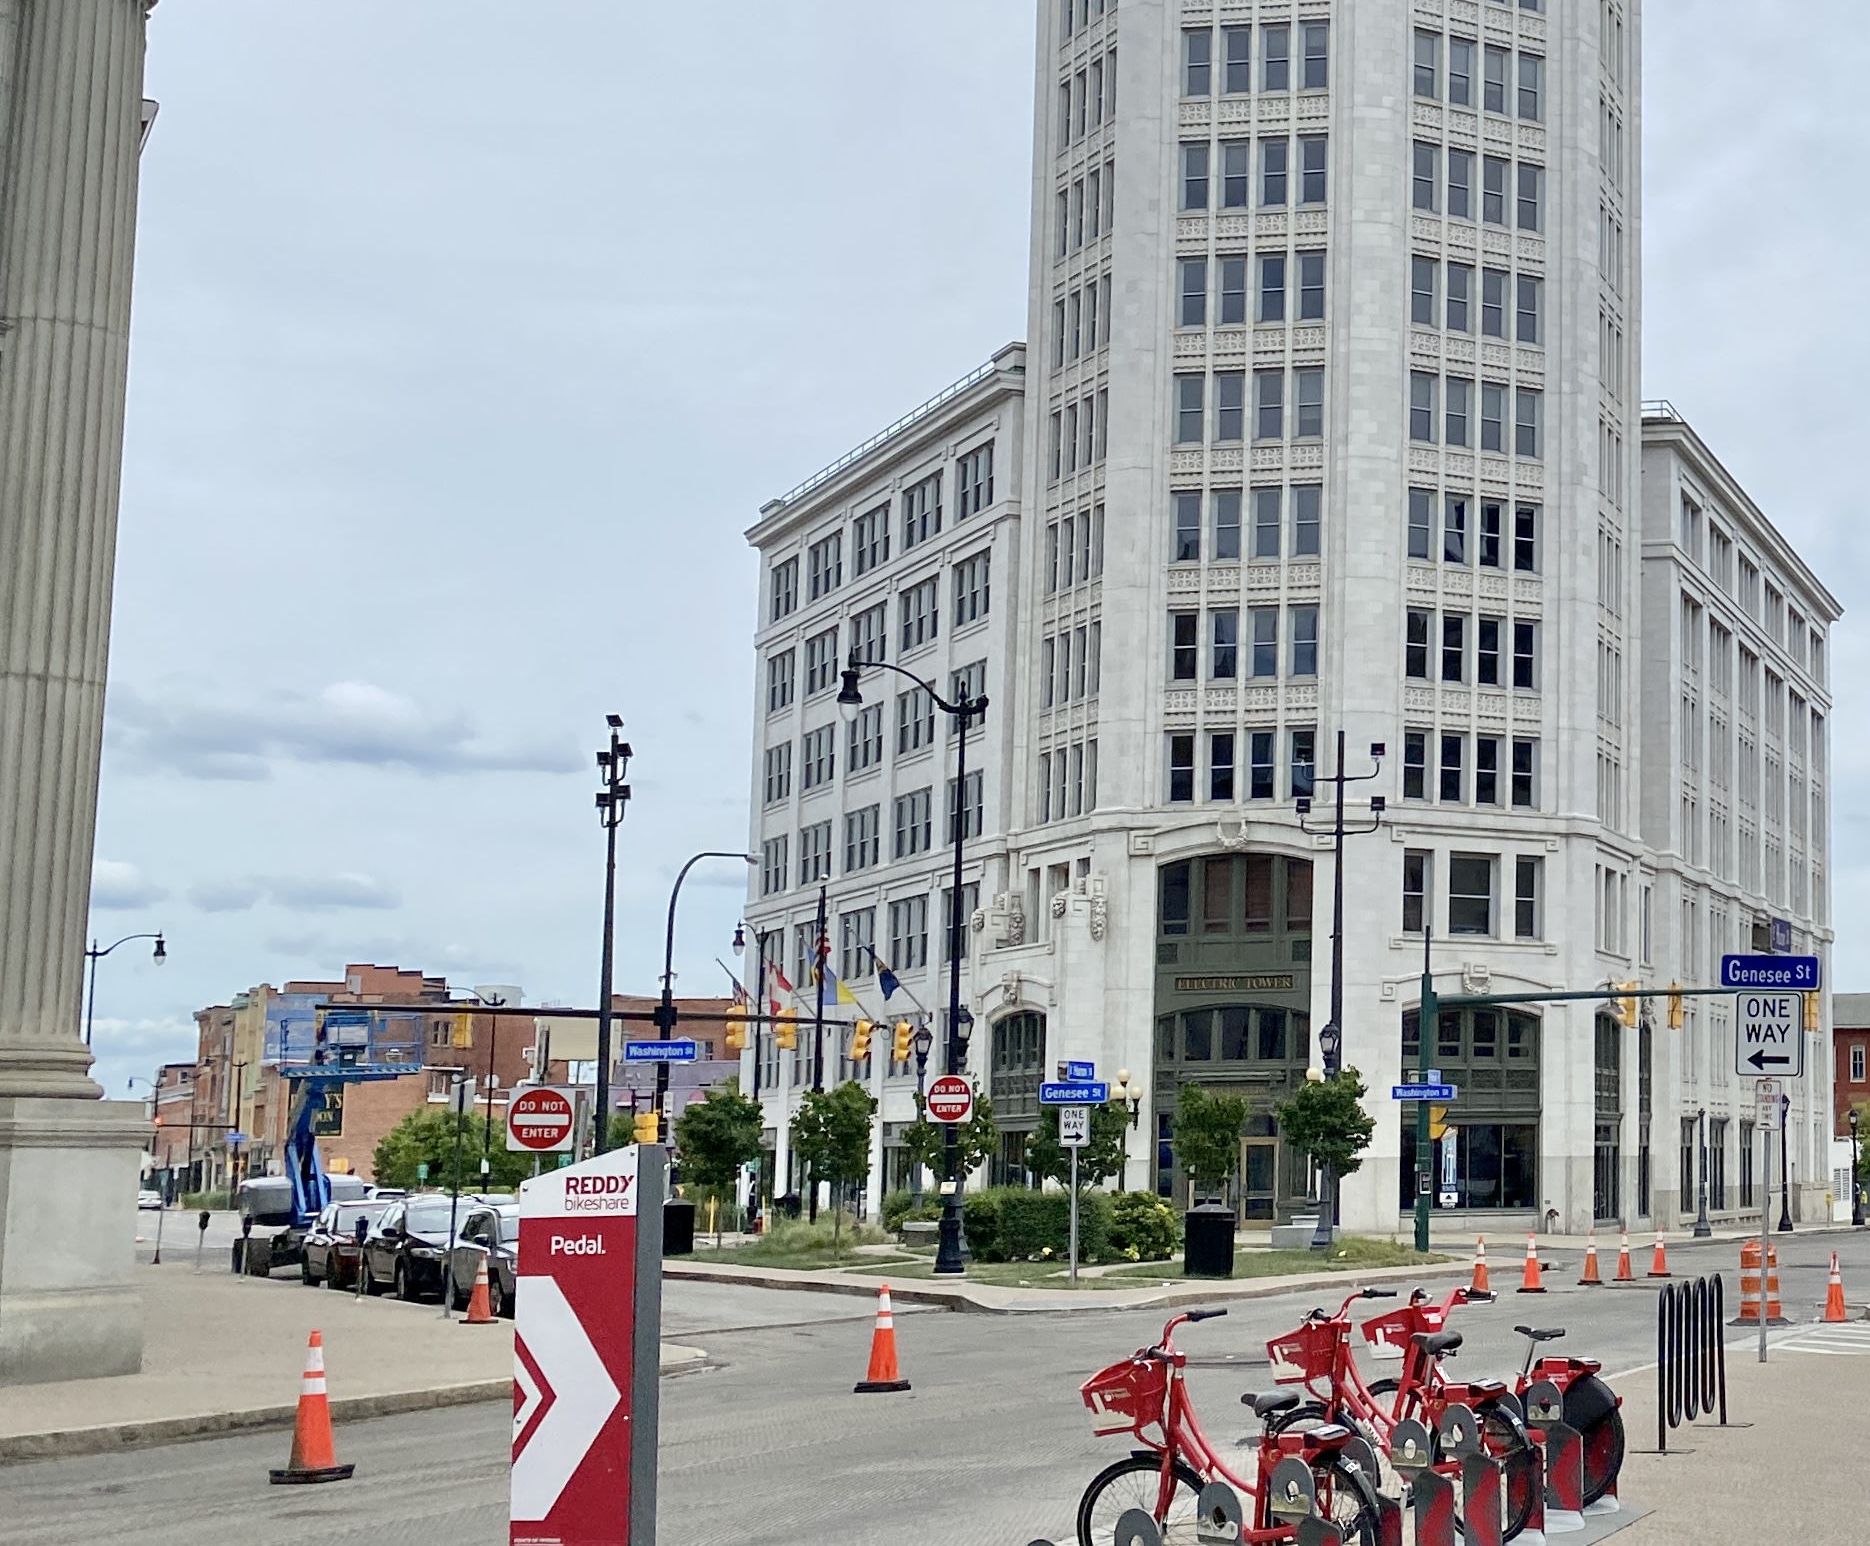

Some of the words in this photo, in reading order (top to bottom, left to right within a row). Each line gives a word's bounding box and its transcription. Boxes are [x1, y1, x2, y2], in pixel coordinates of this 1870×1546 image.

[1728, 959, 1792, 984] Genesee
[1796, 964, 1811, 980] St
[1177, 978, 1239, 990] ELECTRIC
[1245, 976, 1292, 989] TOWER
[1747, 998, 1790, 1018] ONE
[1746, 1024, 1790, 1043] WAY
[629, 1045, 684, 1059] Washington
[685, 1047, 693, 1055] St
[934, 1085, 946, 1093] DO
[948, 1085, 966, 1093] NOT
[1045, 1087, 1089, 1099] Genesee
[1092, 1088, 1102, 1097] St
[1395, 1087, 1440, 1099] Washington
[1763, 1083, 1772, 1092] NO
[519, 1100, 536, 1111] DO
[542, 1100, 565, 1111] NOT
[936, 1104, 962, 1113] ENTER
[1064, 1110, 1084, 1119] ONE
[1064, 1121, 1084, 1130] WAY
[522, 1127, 559, 1138] ENTER
[565, 1175, 635, 1195] REDDY
[564, 1196, 629, 1211] bikeshare
[551, 1234, 606, 1255] Pedal.
